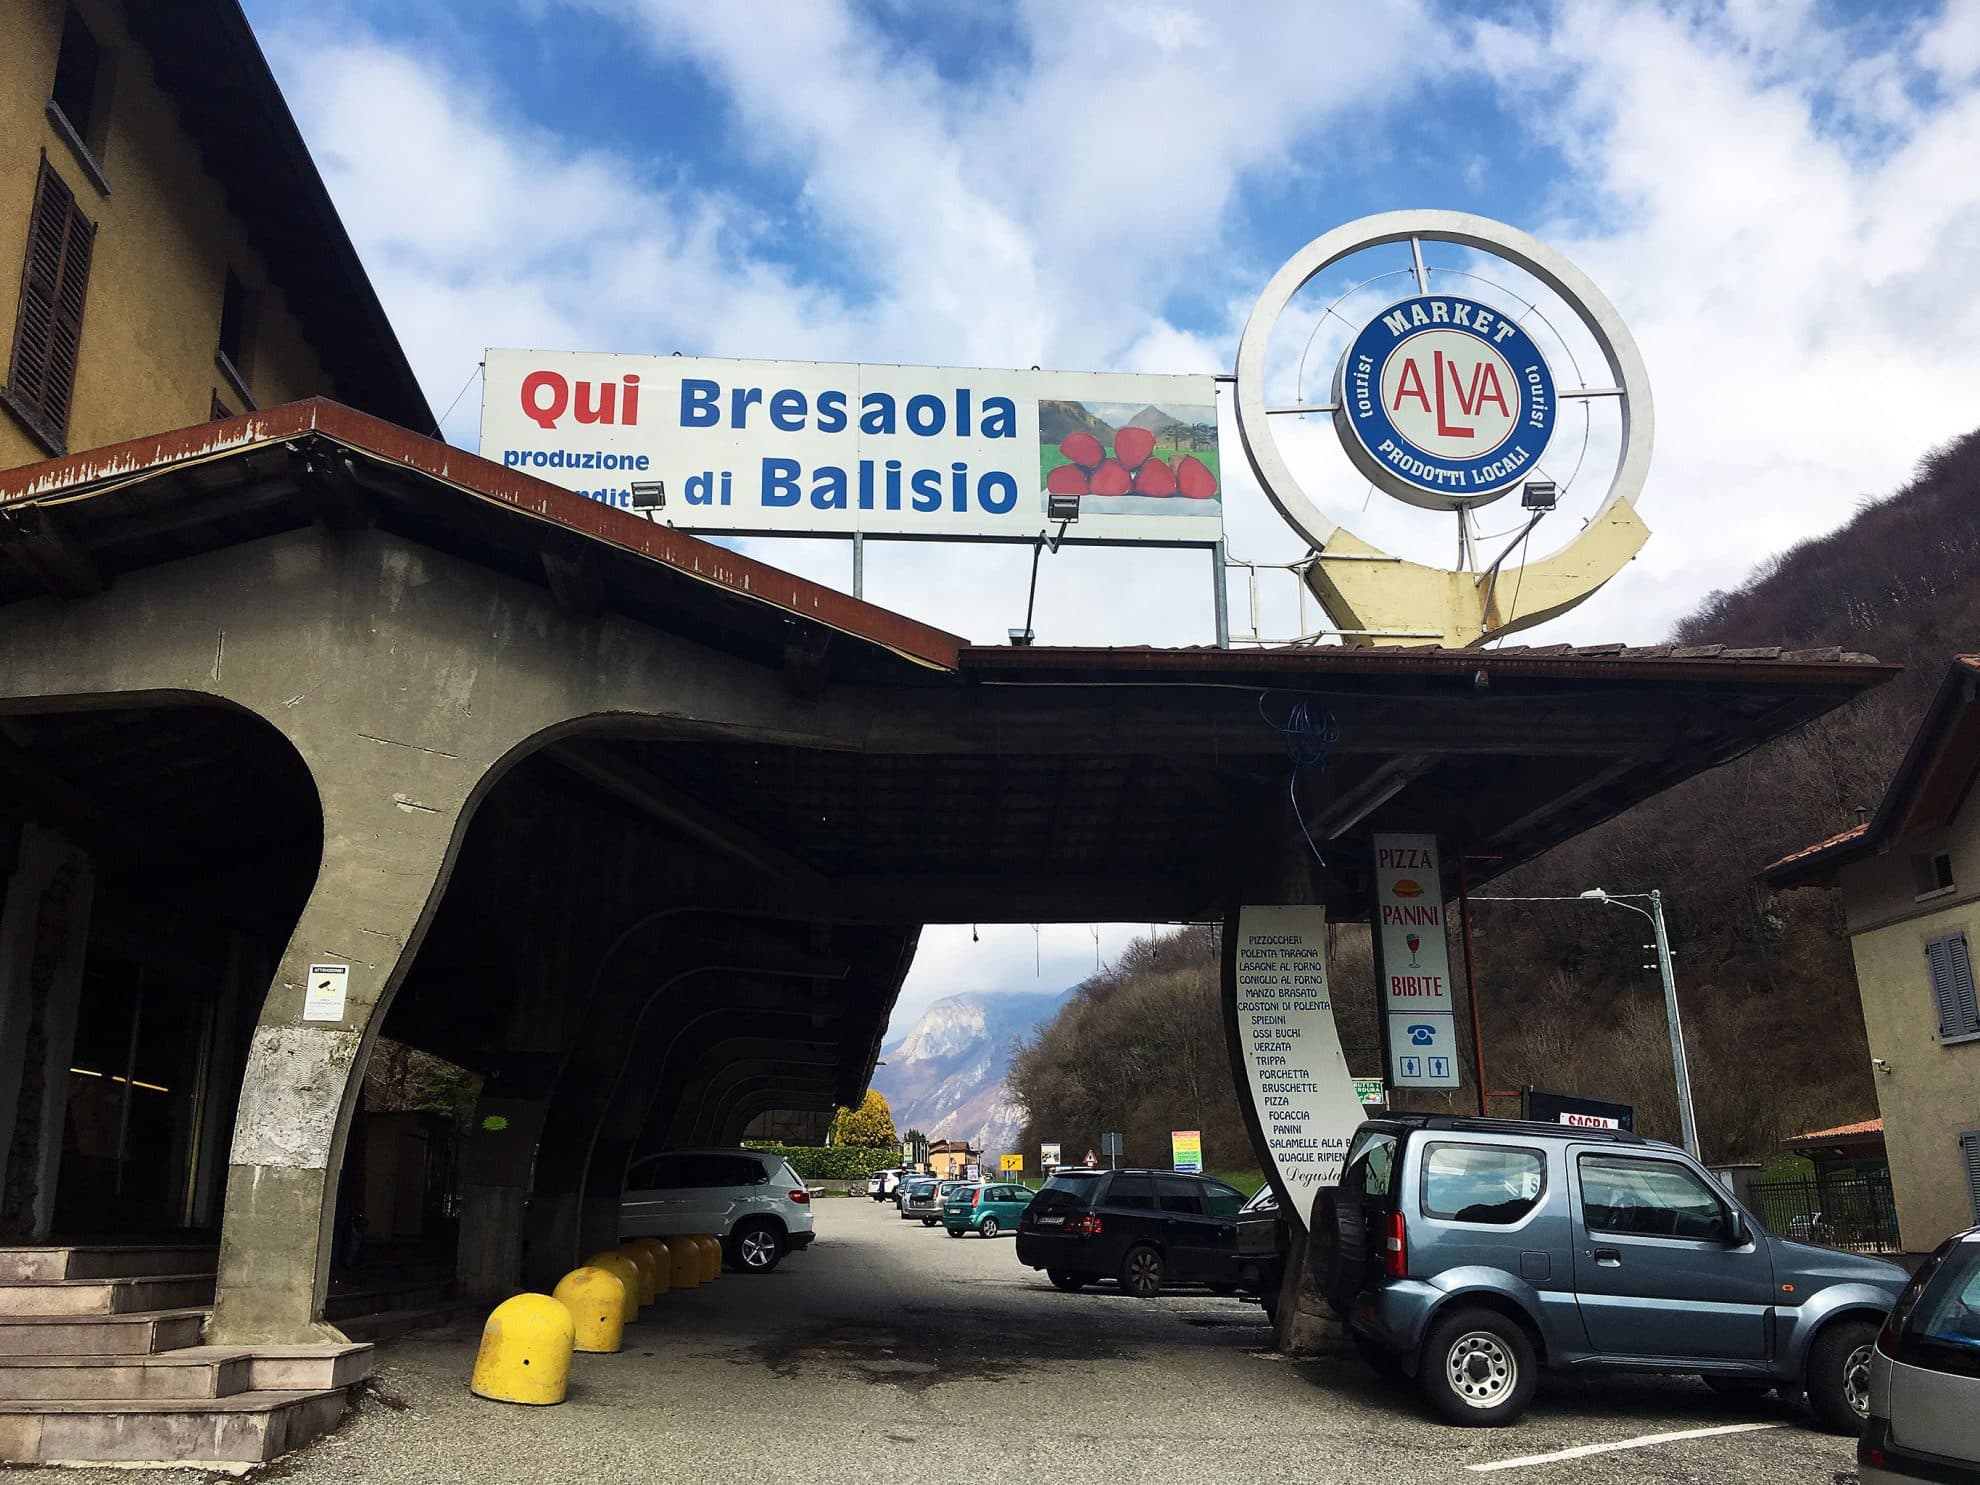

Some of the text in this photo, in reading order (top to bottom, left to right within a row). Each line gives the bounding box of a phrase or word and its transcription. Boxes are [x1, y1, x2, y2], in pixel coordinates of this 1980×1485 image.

[1382, 302, 1516, 343] MARKET
[1353, 354, 1374, 418] tourist
[1392, 350, 1510, 438] ALVA
[1525, 365, 1549, 429] tourist
[520, 370, 1017, 439] Qui Bresaola
[503, 449, 650, 471] produzione
[1378, 439, 1530, 486] PRODOTTI LOCALI
[684, 457, 1018, 515] di Balisio
[1379, 849, 1432, 868] PIZZA
[1383, 905, 1439, 926] PANINI
[1249, 936, 1301, 944] PIZZOCCHERI
[1241, 949, 1318, 957] POLENTA TARAGNA
[1240, 963, 1321, 971] LASAGNE AL FORNO
[1240, 976, 1322, 984] CONIGLIO AL FORNO
[1391, 976, 1443, 997] BIBITE
[1246, 989, 1317, 997] MANZO BRASATO
[1238, 1002, 1330, 1011] CROSTONI DI POLENTA
[1252, 1016, 1285, 1024] SPIEDINI
[1253, 1029, 1300, 1038] OSSI BUCHI
[1255, 1042, 1291, 1051] VERZATA
[1256, 1056, 1286, 1065] TRIPPA
[1260, 1070, 1309, 1079] PORCHETTA
[1263, 1083, 1318, 1092] BRUSCHETTE
[1265, 1097, 1289, 1106] PIZZA
[1269, 1111, 1310, 1120] FOCACCIA
[1274, 1125, 1301, 1134] PANINI
[1269, 1139, 1318, 1148] SALAMELLE
[1322, 1139, 1342, 1147] ALLA
[1279, 1153, 1346, 1162] QUAGLIE RIPIEN
